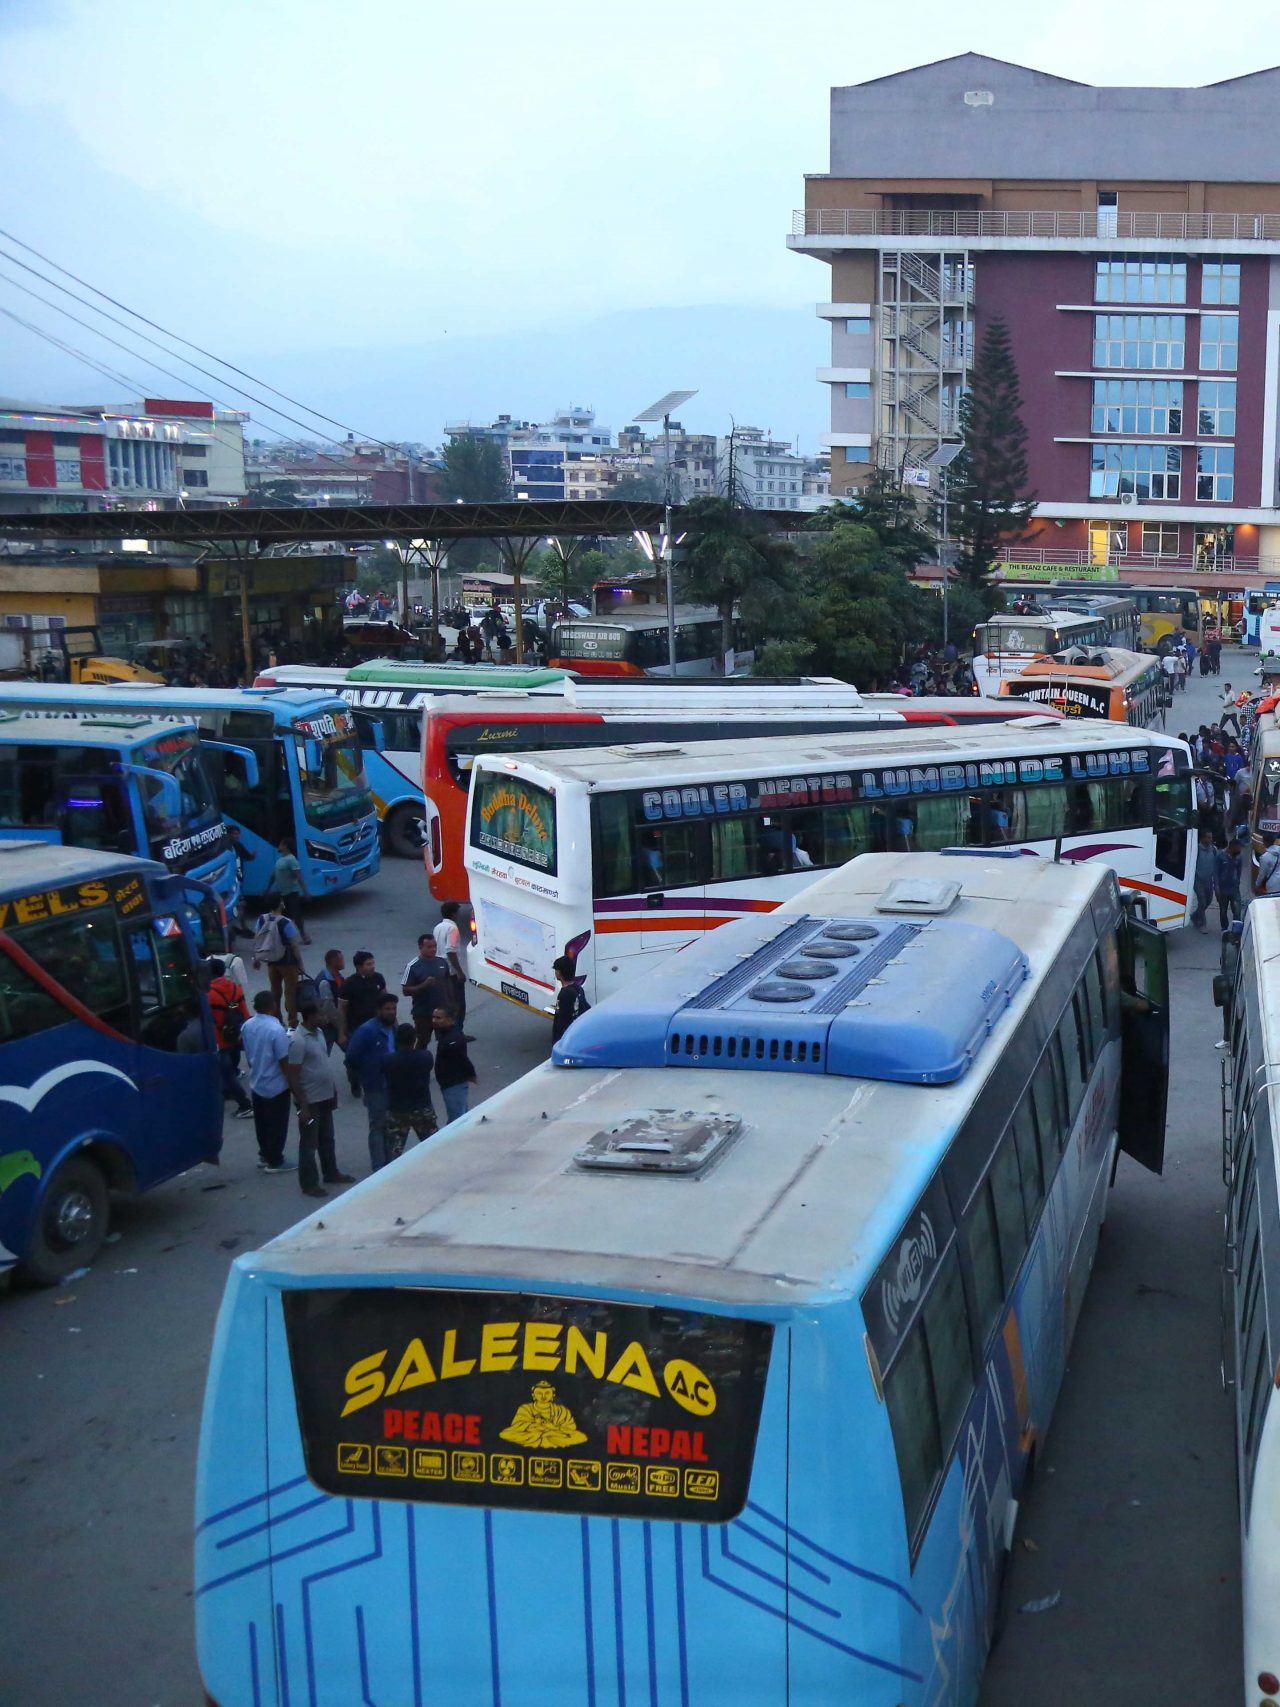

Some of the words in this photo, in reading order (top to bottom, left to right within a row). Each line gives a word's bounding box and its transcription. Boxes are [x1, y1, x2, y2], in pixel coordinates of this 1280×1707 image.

[562, 630, 597, 640] BAGESWARI
[597, 631, 608, 640] AIR
[608, 631, 621, 640] BUS
[1062, 689, 1089, 706] QUEEN
[642, 783, 750, 821] COOLER
[758, 773, 853, 807] HEATER
[480, 789, 517, 824] Buddha
[519, 794, 548, 840] Deluxe
[340, 1322, 662, 1418] SALEENA
[383, 1407, 481, 1446] PEACE
[606, 1424, 709, 1463] NEPAL
[416, 1468, 443, 1476] HEATER
[610, 1482, 636, 1491] Music
[687, 1474, 716, 1486] LED
[650, 1484, 676, 1493] FREE
